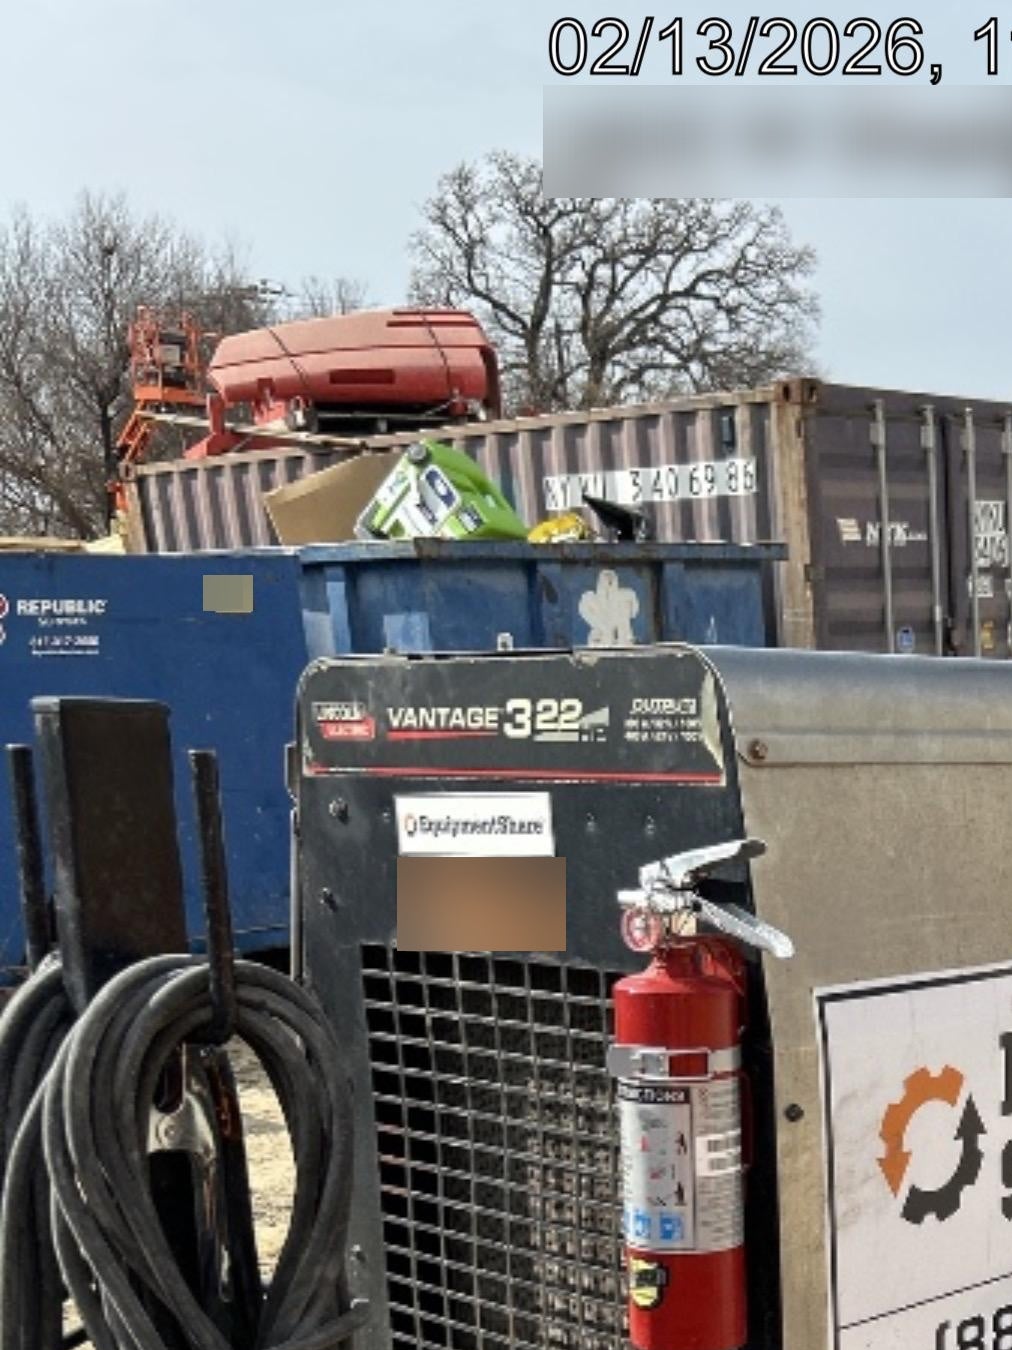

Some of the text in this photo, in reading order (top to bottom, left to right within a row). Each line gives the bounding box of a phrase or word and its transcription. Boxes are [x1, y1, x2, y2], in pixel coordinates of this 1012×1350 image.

[17, 599, 107, 616] REPUBLIC
[387, 707, 499, 729] VANTAGE
[503, 698, 582, 739] 322
